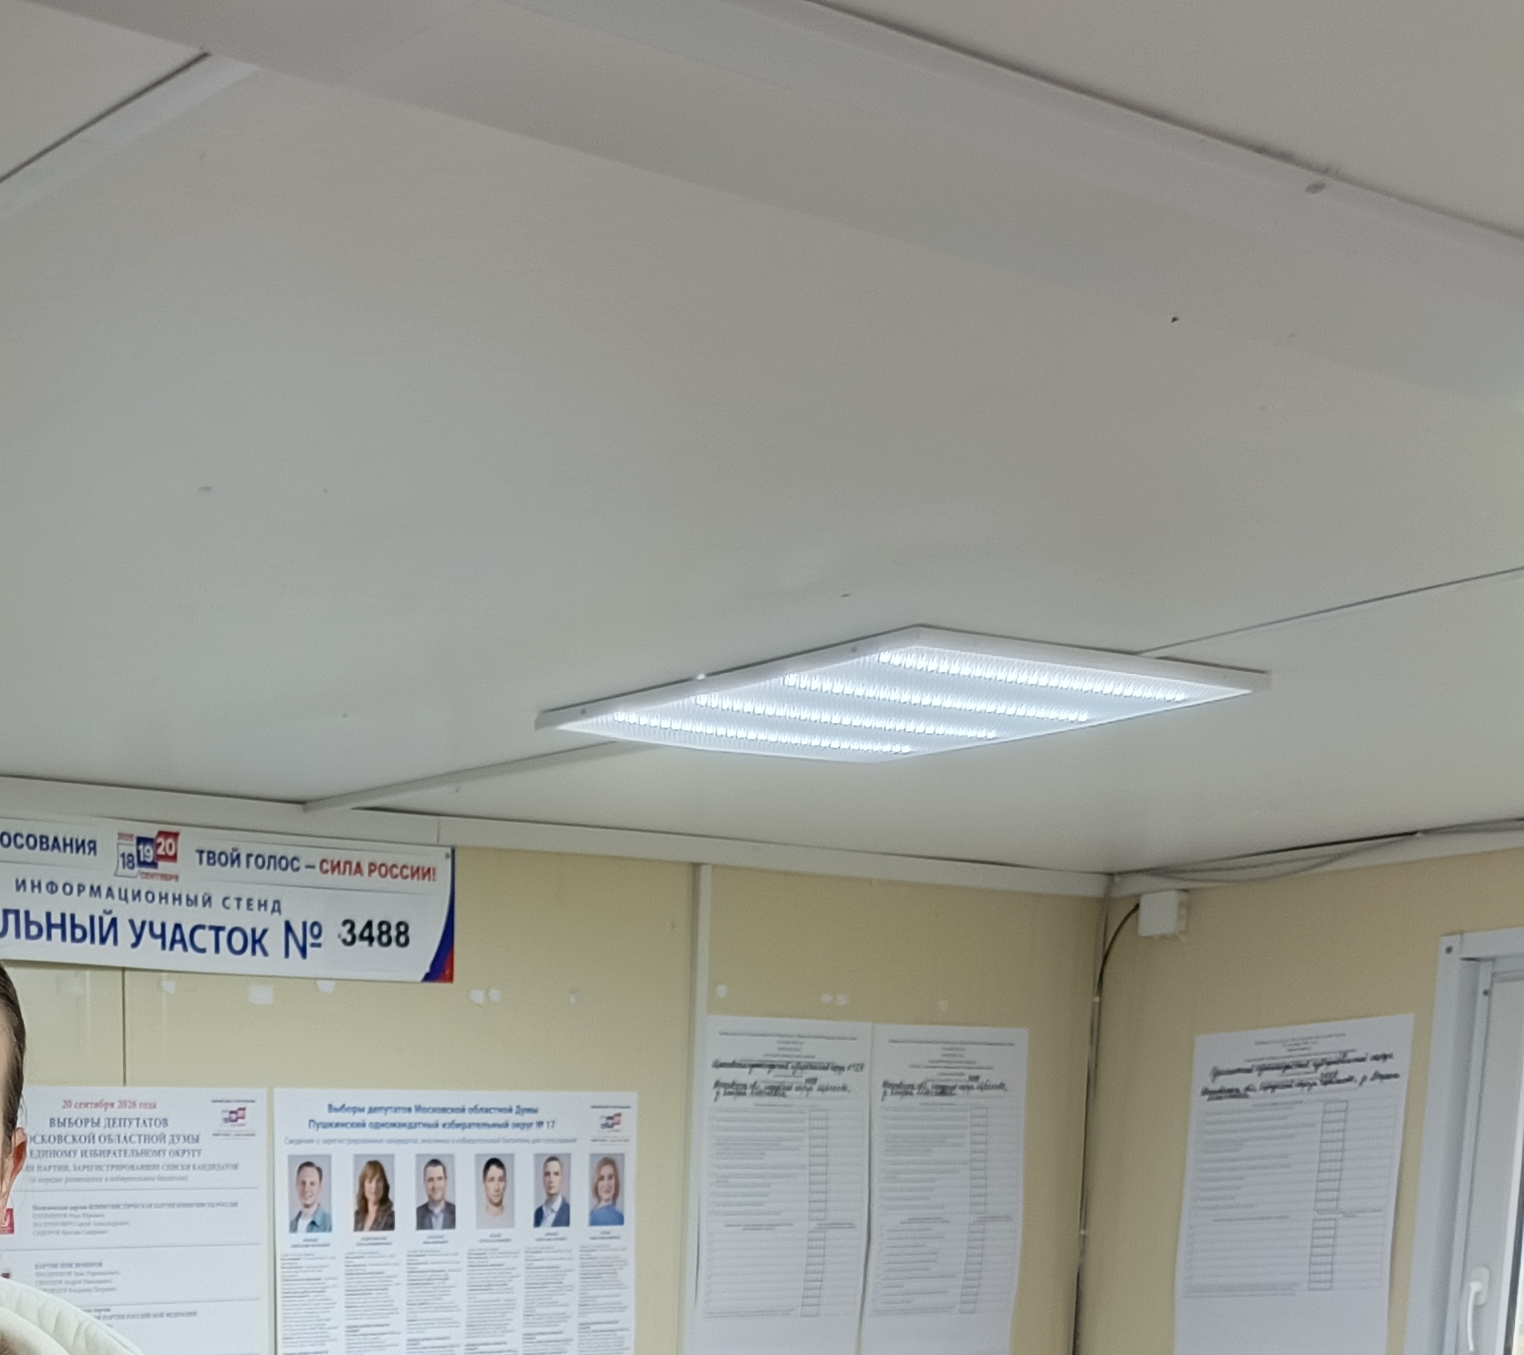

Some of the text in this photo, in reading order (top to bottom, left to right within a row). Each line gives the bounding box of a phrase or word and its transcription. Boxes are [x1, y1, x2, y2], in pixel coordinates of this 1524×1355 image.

[120, 838, 176, 870] 18 19 20
[195, 848, 241, 869] ТВОЙ
[245, 852, 301, 873] ГОЛОС
[319, 858, 363, 877] СИЛА
[368, 863, 437, 882] РОССИИ!
[15, 878, 282, 915] ИНФОРМАЦИОННЫЙ СТЕНД
[128, 917, 269, 957] УЧАСТОК
[284, 919, 323, 960] №
[339, 918, 411, 948] 3488
[28, 1132, 96, 1144] СКОВСКОЙ
[49, 1117, 169, 1129] ВЫБОРЫ ДЕПУТАТОВ
